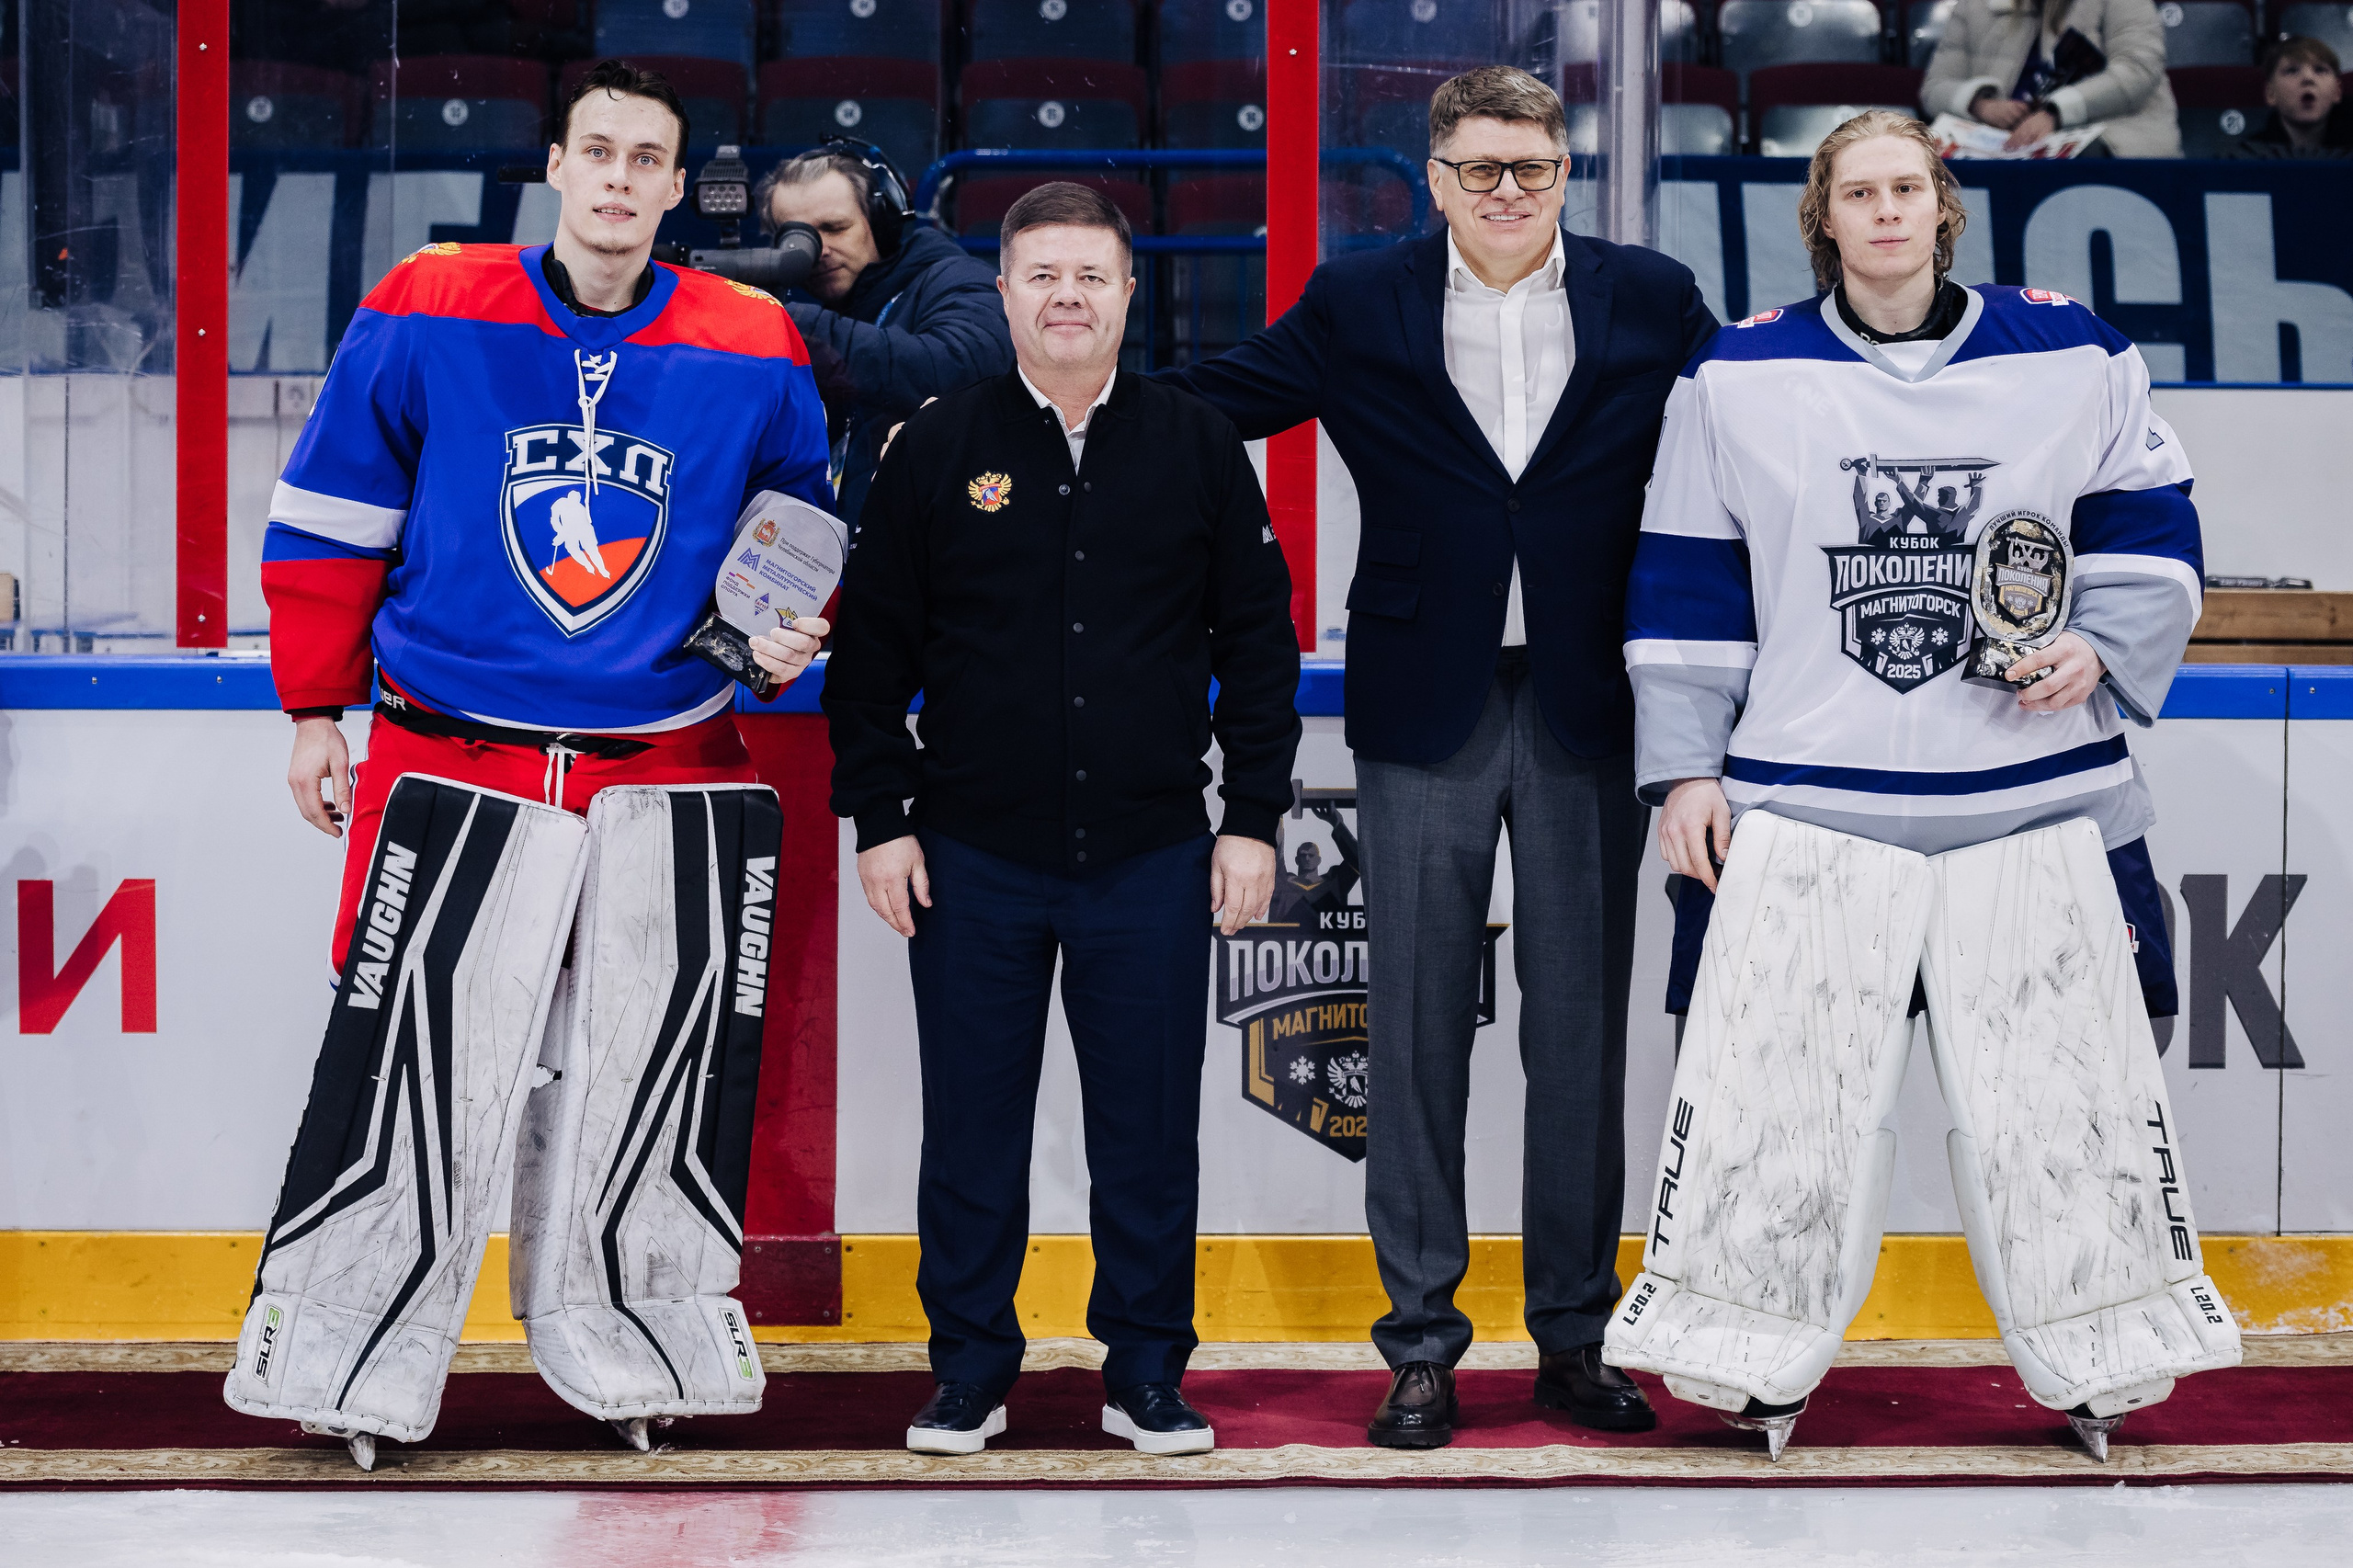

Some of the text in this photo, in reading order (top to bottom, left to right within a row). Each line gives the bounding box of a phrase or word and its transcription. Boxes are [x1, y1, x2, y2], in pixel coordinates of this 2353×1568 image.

[511, 429, 668, 497] СХП
[1889, 536, 1939, 550] КУБОК
[1989, 510, 2070, 548] ЛУЧШИЙ ИГРОК КОМАНДЫ
[758, 570, 790, 592] КОМБИНАТ
[762, 564, 818, 602] МЕТАЛЛУРГИЧЕСКИЙ
[766, 559, 817, 593] МАГНИТОГОРСКИЙ
[1834, 552, 1973, 595] ПОКОЛЕНИ
[1997, 569, 2049, 595] ПОКОЛЕНИЯ
[1859, 593, 1961, 619] МАГНИТОГОРСК
[1887, 663, 1921, 679] 2025
[347, 840, 418, 1010] VAUGHN
[734, 856, 776, 1017] VAUGHN
[1320, 911, 1367, 929] КУБ
[1226, 939, 1369, 1003] ПОКОЛ
[1272, 1003, 1369, 1040] МАГНИТ
[1329, 1116, 1368, 1138] 202
[1652, 1096, 1695, 1258] TRUE
[2146, 1099, 2193, 1261] TRUE
[1622, 1282, 1657, 1326] L20.2
[2189, 1287, 2223, 1324] L20.2
